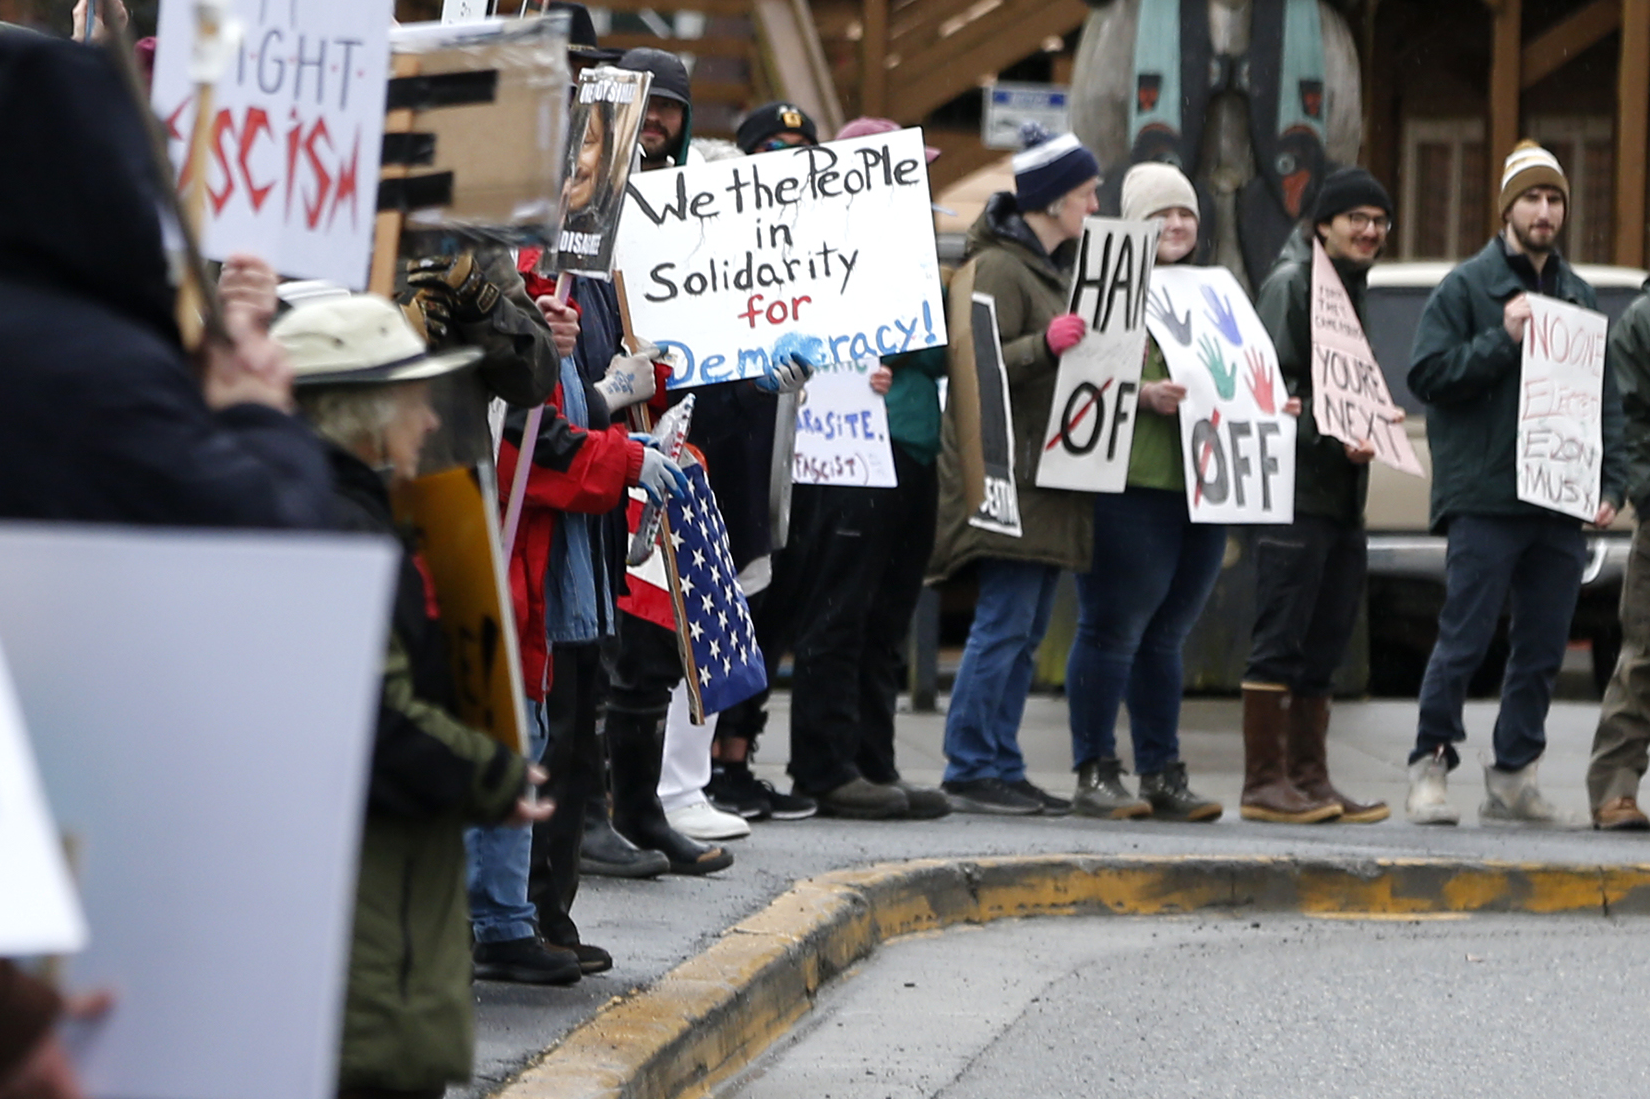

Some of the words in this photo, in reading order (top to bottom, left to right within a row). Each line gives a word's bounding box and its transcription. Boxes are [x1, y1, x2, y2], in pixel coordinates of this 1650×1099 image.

[625, 171, 720, 225] We
[726, 163, 799, 214] the
[756, 218, 793, 249] in
[643, 241, 859, 302] Solidarity
[738, 293, 813, 329] for
[1529, 309, 1571, 364] NO
[1324, 392, 1403, 463] NEXT
